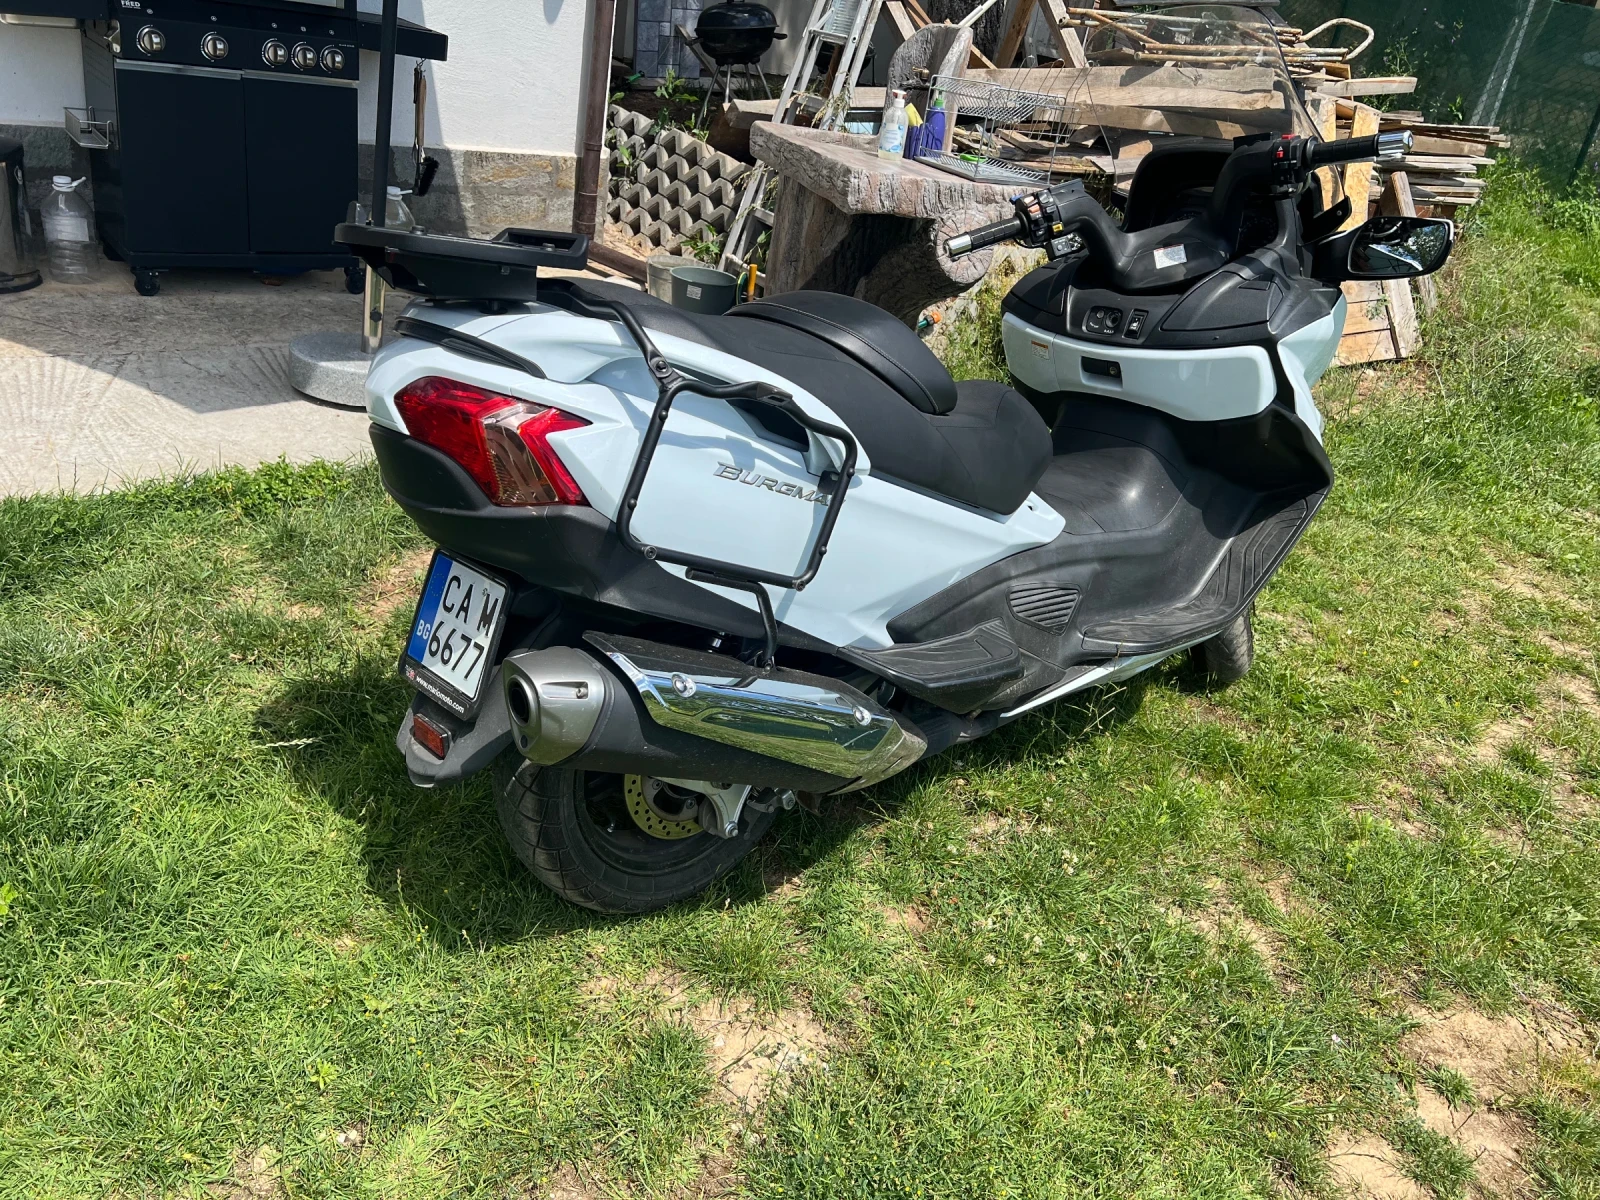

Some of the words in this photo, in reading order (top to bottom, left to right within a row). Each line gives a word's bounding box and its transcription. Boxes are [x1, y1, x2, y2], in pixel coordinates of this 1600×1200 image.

[713, 461, 846, 506] BURGMA
[442, 575, 475, 625] CA
[476, 593, 500, 638] M
[416, 619, 431, 640] BG
[428, 620, 485, 681] 6677
[416, 675, 465, 714] www.mariomoto.com
